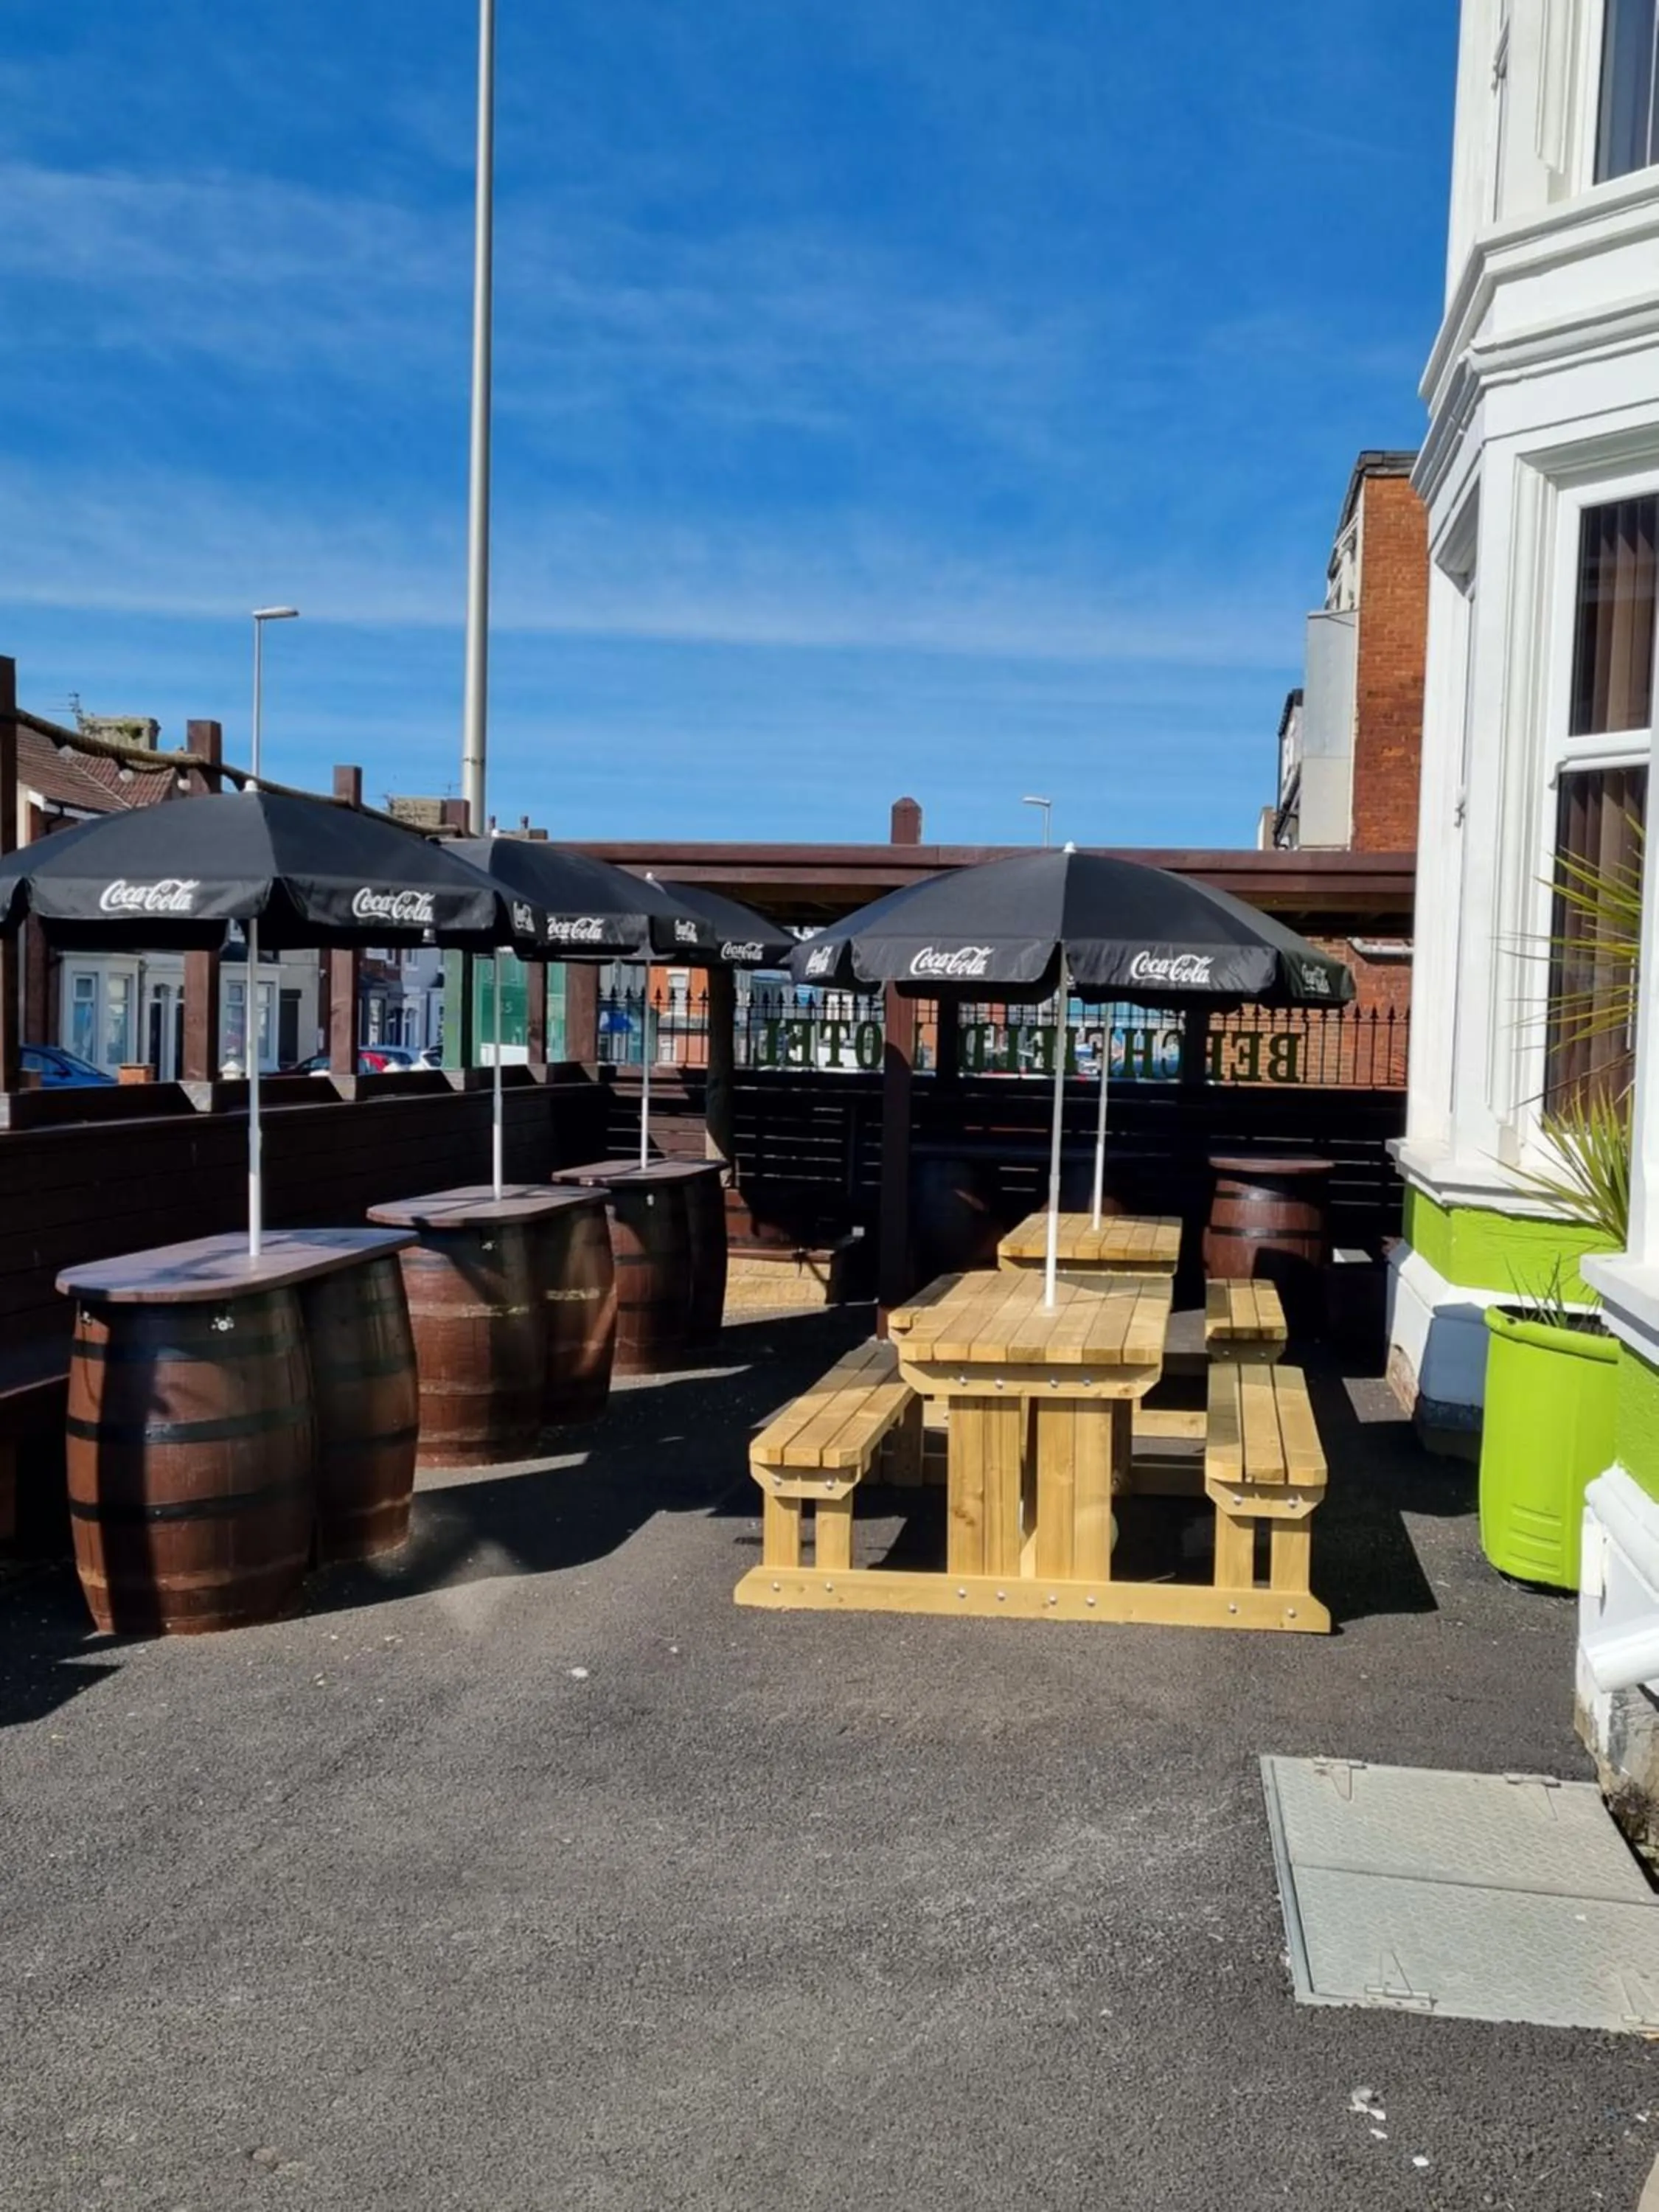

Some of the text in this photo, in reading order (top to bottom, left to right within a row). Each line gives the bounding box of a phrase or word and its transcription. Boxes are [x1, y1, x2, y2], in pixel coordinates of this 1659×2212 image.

[100, 878, 200, 911] Coca-Cola
[352, 887, 436, 922] Coca-Cola
[910, 946, 995, 975] Coca-Cola
[1130, 950, 1214, 984] Coca-Cola
